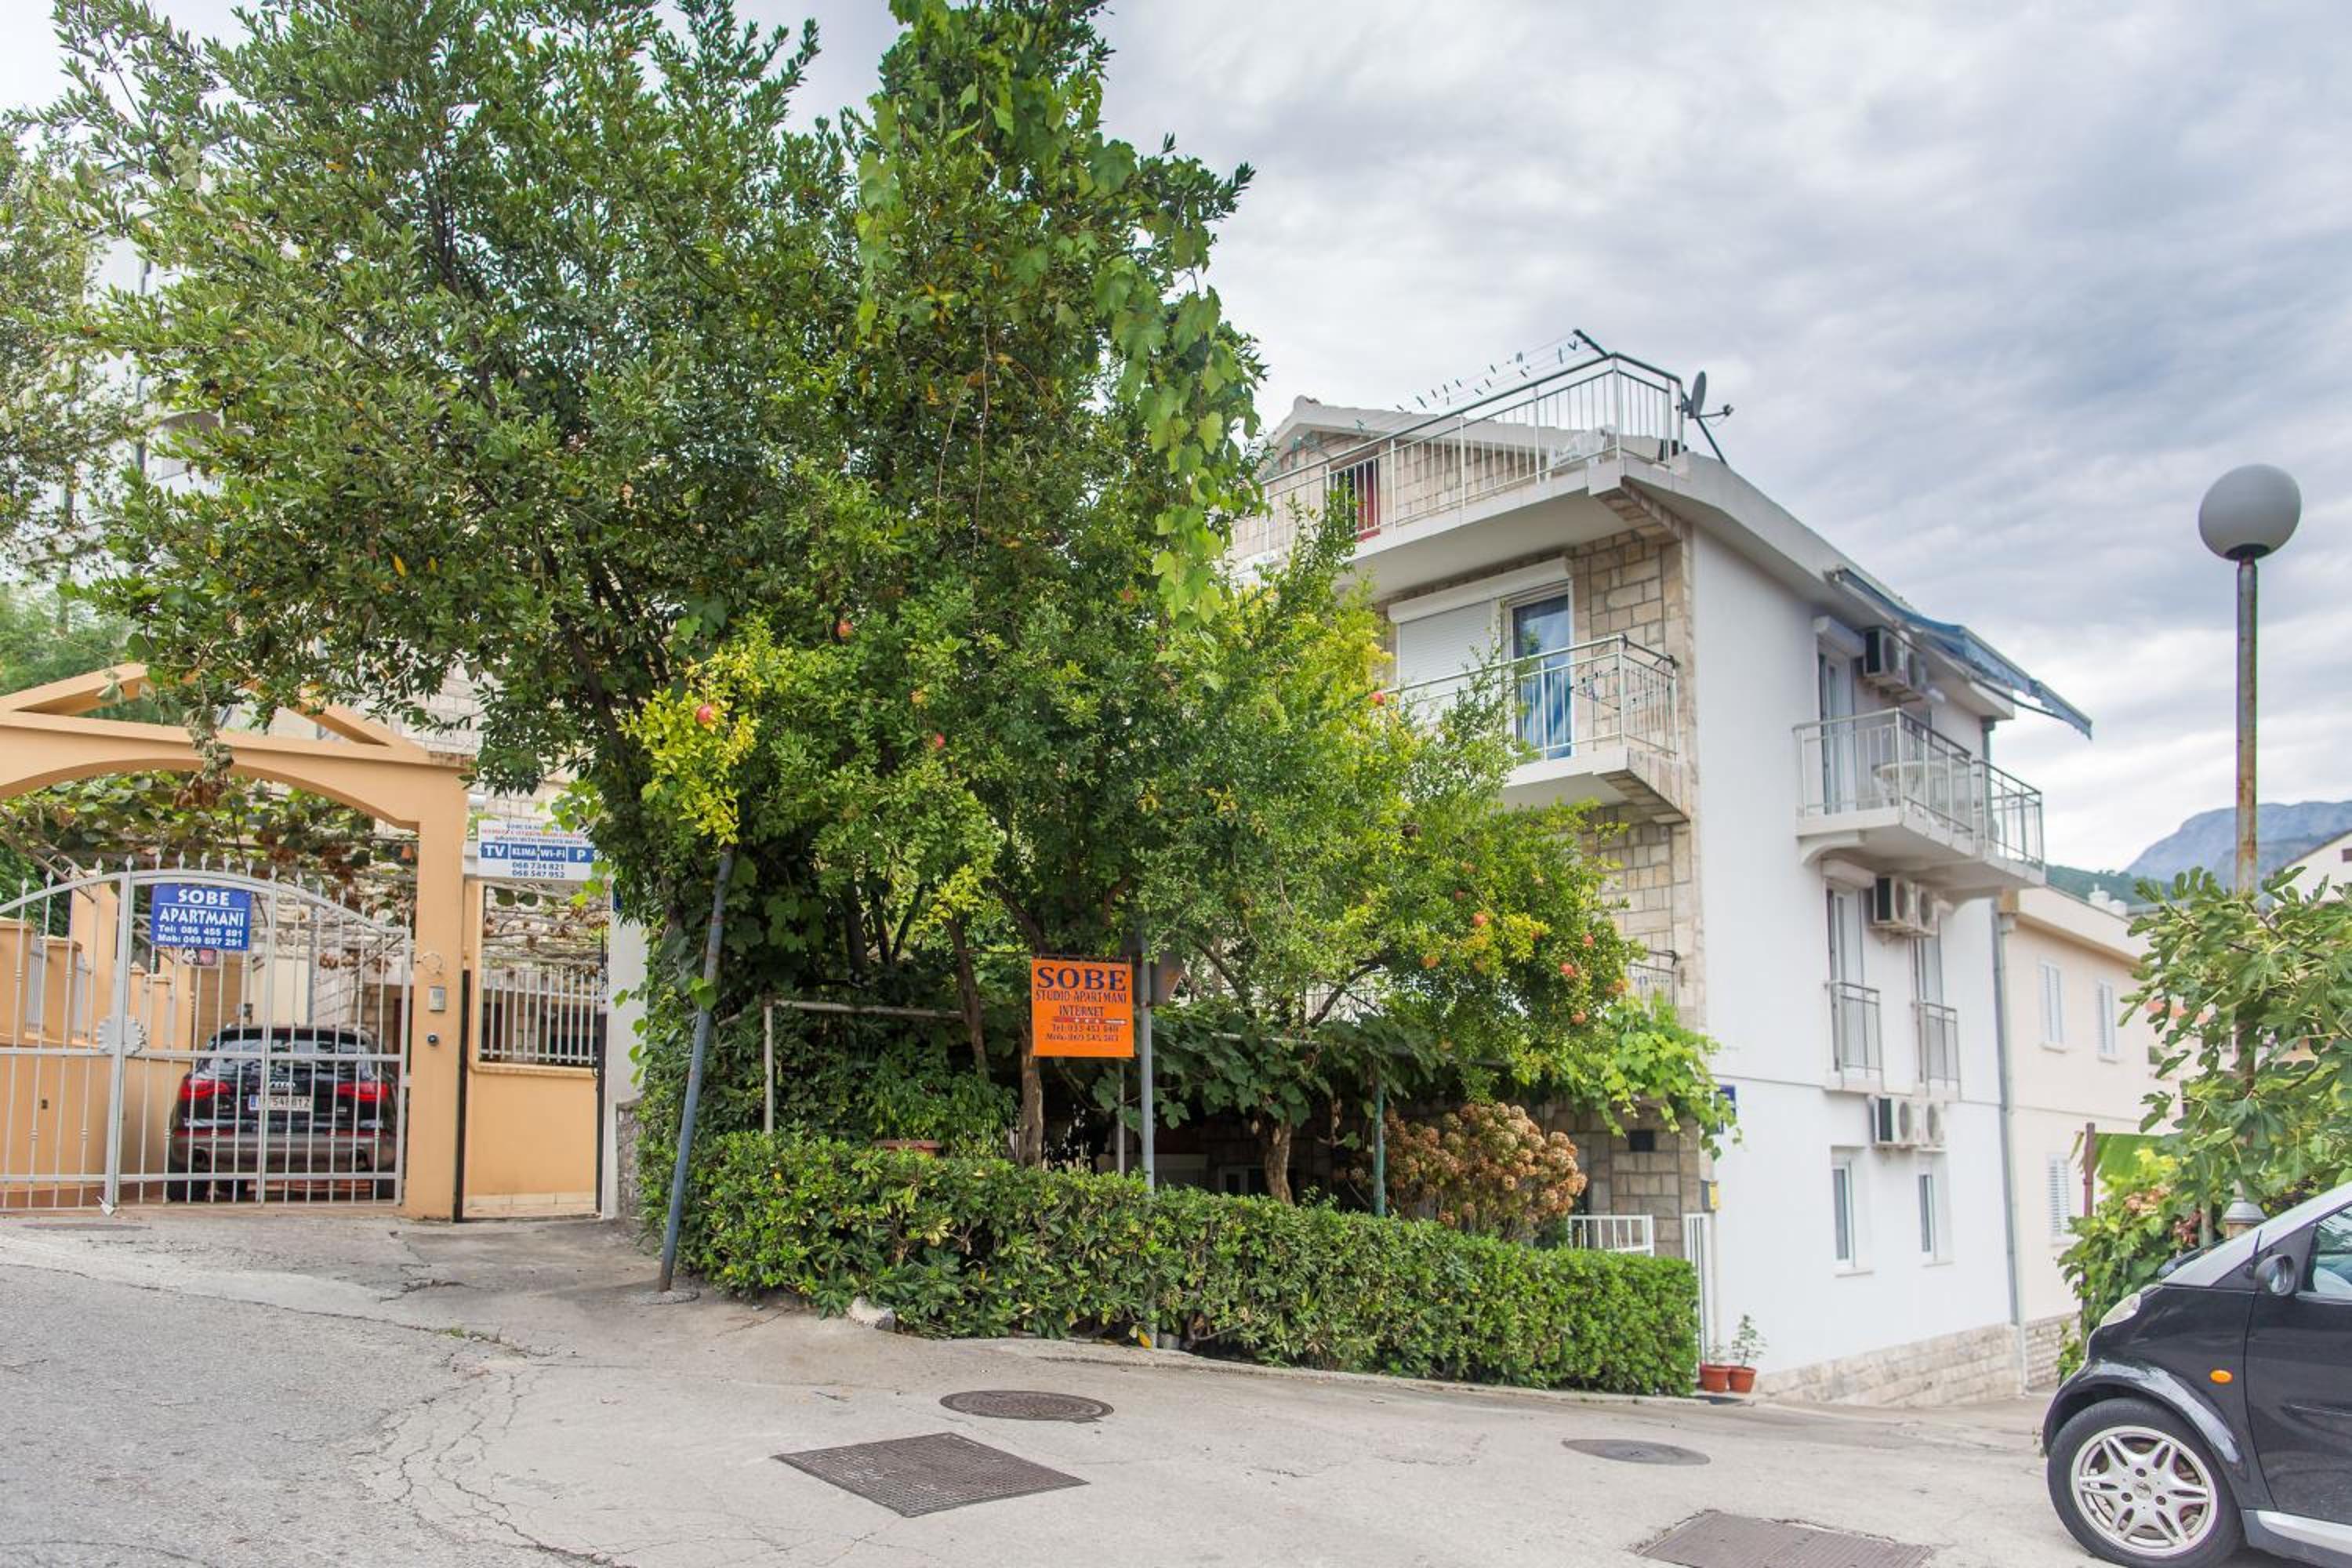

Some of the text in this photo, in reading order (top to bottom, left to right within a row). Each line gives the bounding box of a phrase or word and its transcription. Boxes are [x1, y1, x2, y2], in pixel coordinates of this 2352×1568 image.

[485, 844, 506, 857] TV
[512, 848, 536, 857] KLIMA
[576, 850, 586, 861] P
[178, 889, 230, 906] SOBE
[159, 907, 245, 927] APARTMANI
[1037, 967, 1127, 991] SOBE
[1036, 990, 1127, 1004] STUDIO APARTMANI
[1059, 1005, 1104, 1017] INTERNET
